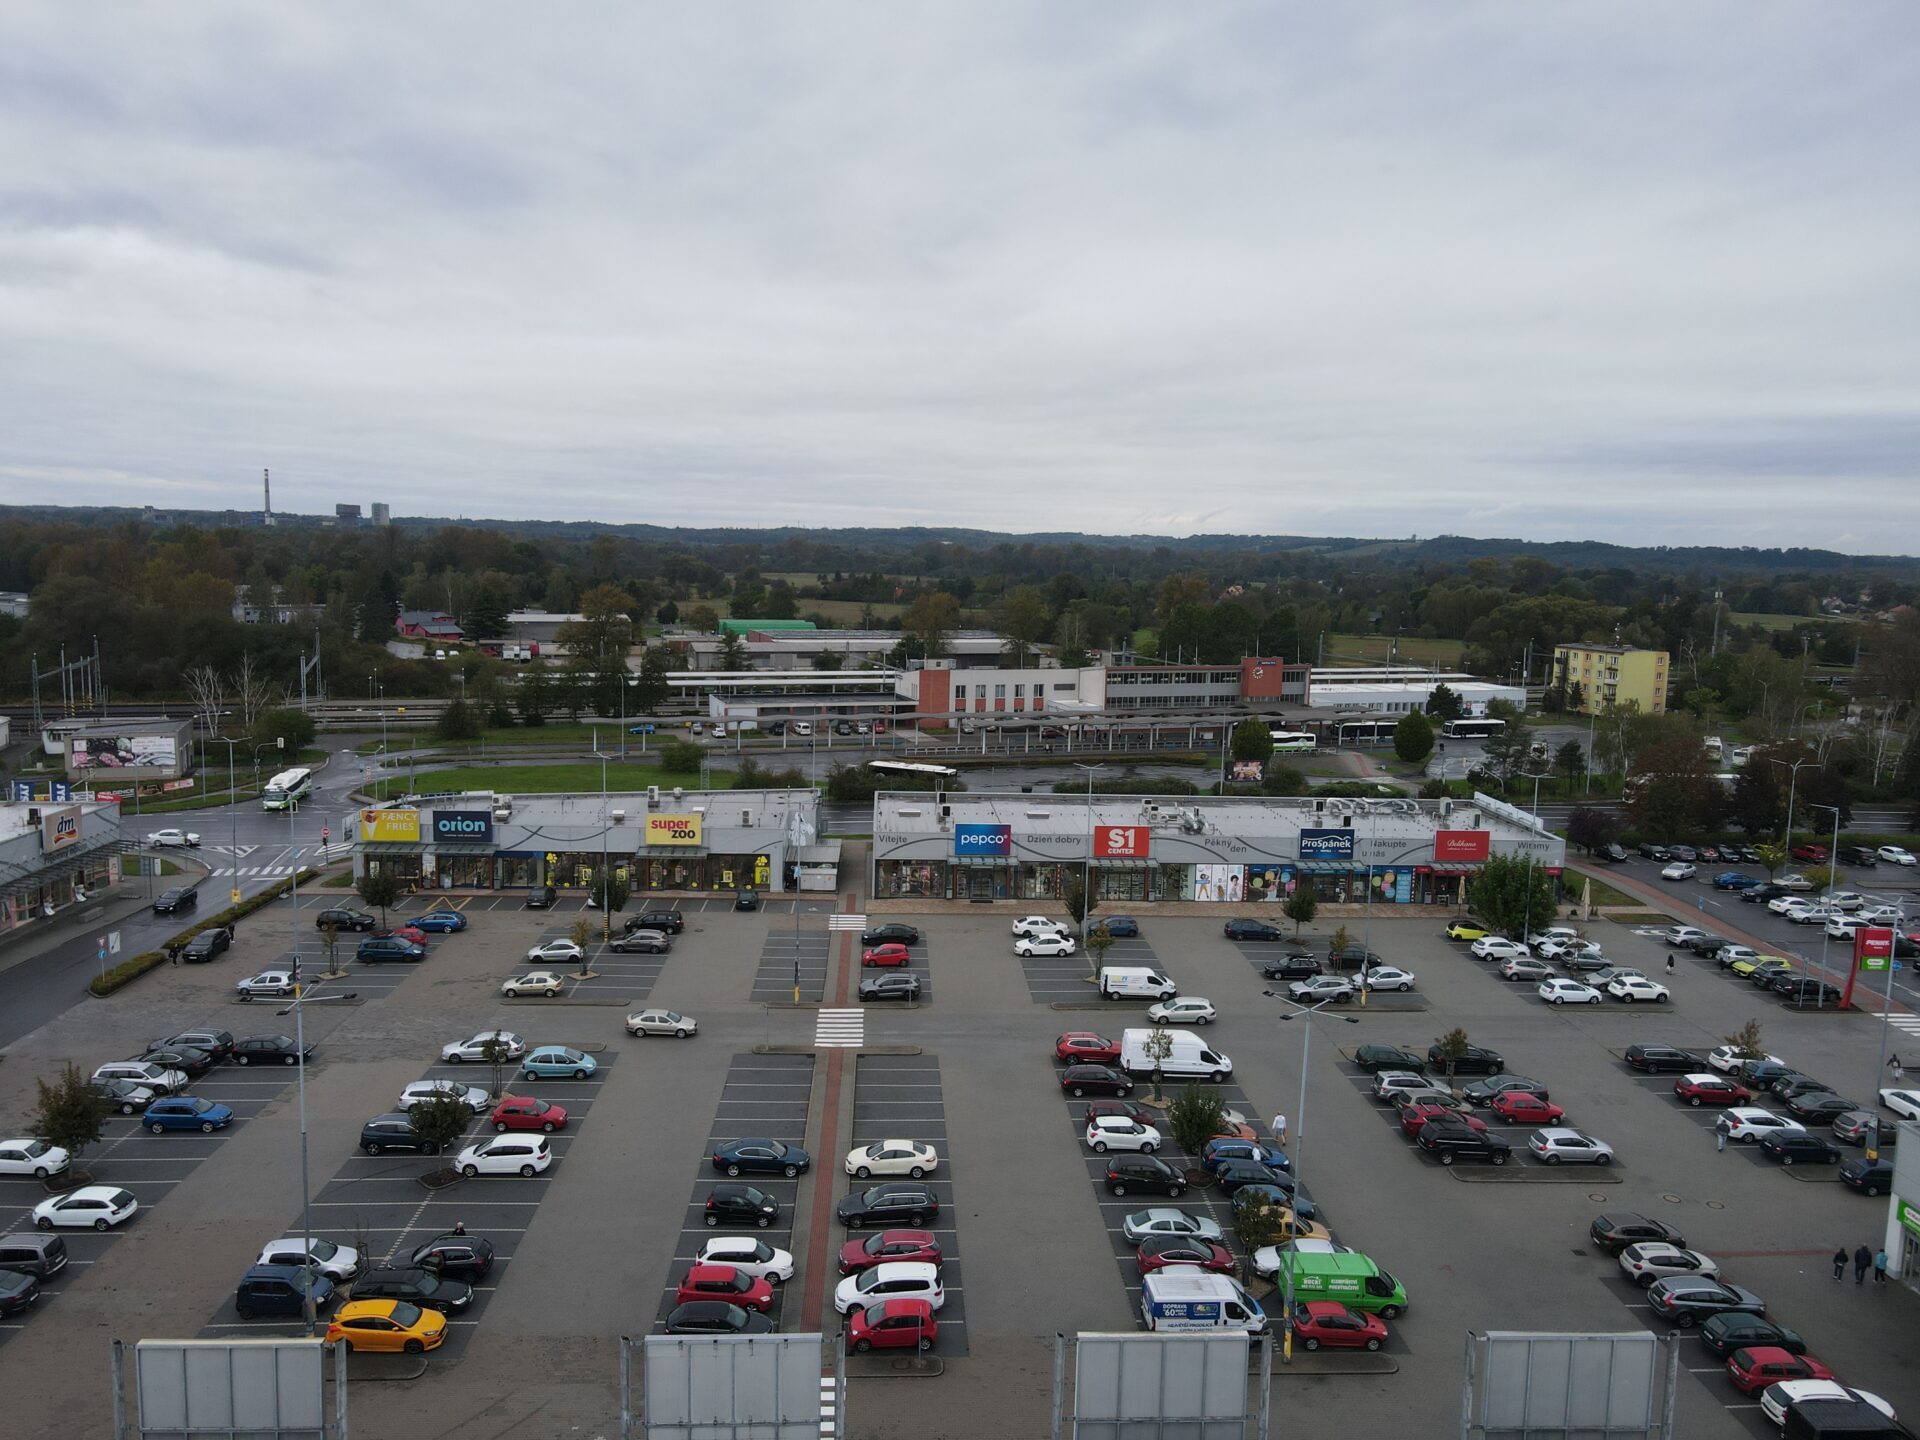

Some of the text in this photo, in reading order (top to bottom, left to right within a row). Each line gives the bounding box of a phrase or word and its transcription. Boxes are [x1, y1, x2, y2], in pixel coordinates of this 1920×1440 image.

[20, 783, 30, 801] JYS
[56, 783, 66, 801] JYS
[57, 815, 74, 833] dm
[386, 822, 414, 831] FRIES
[438, 816, 486, 832] orion
[651, 819, 690, 831] super
[671, 829, 696, 839] zoo
[961, 834, 1004, 845] pepco
[1107, 828, 1136, 848] S1
[1055, 835, 1081, 846] dobry
[1301, 838, 1352, 849] ProSpánek
[1230, 845, 1247, 853] den
[1164, 1309, 1176, 1317] 60
